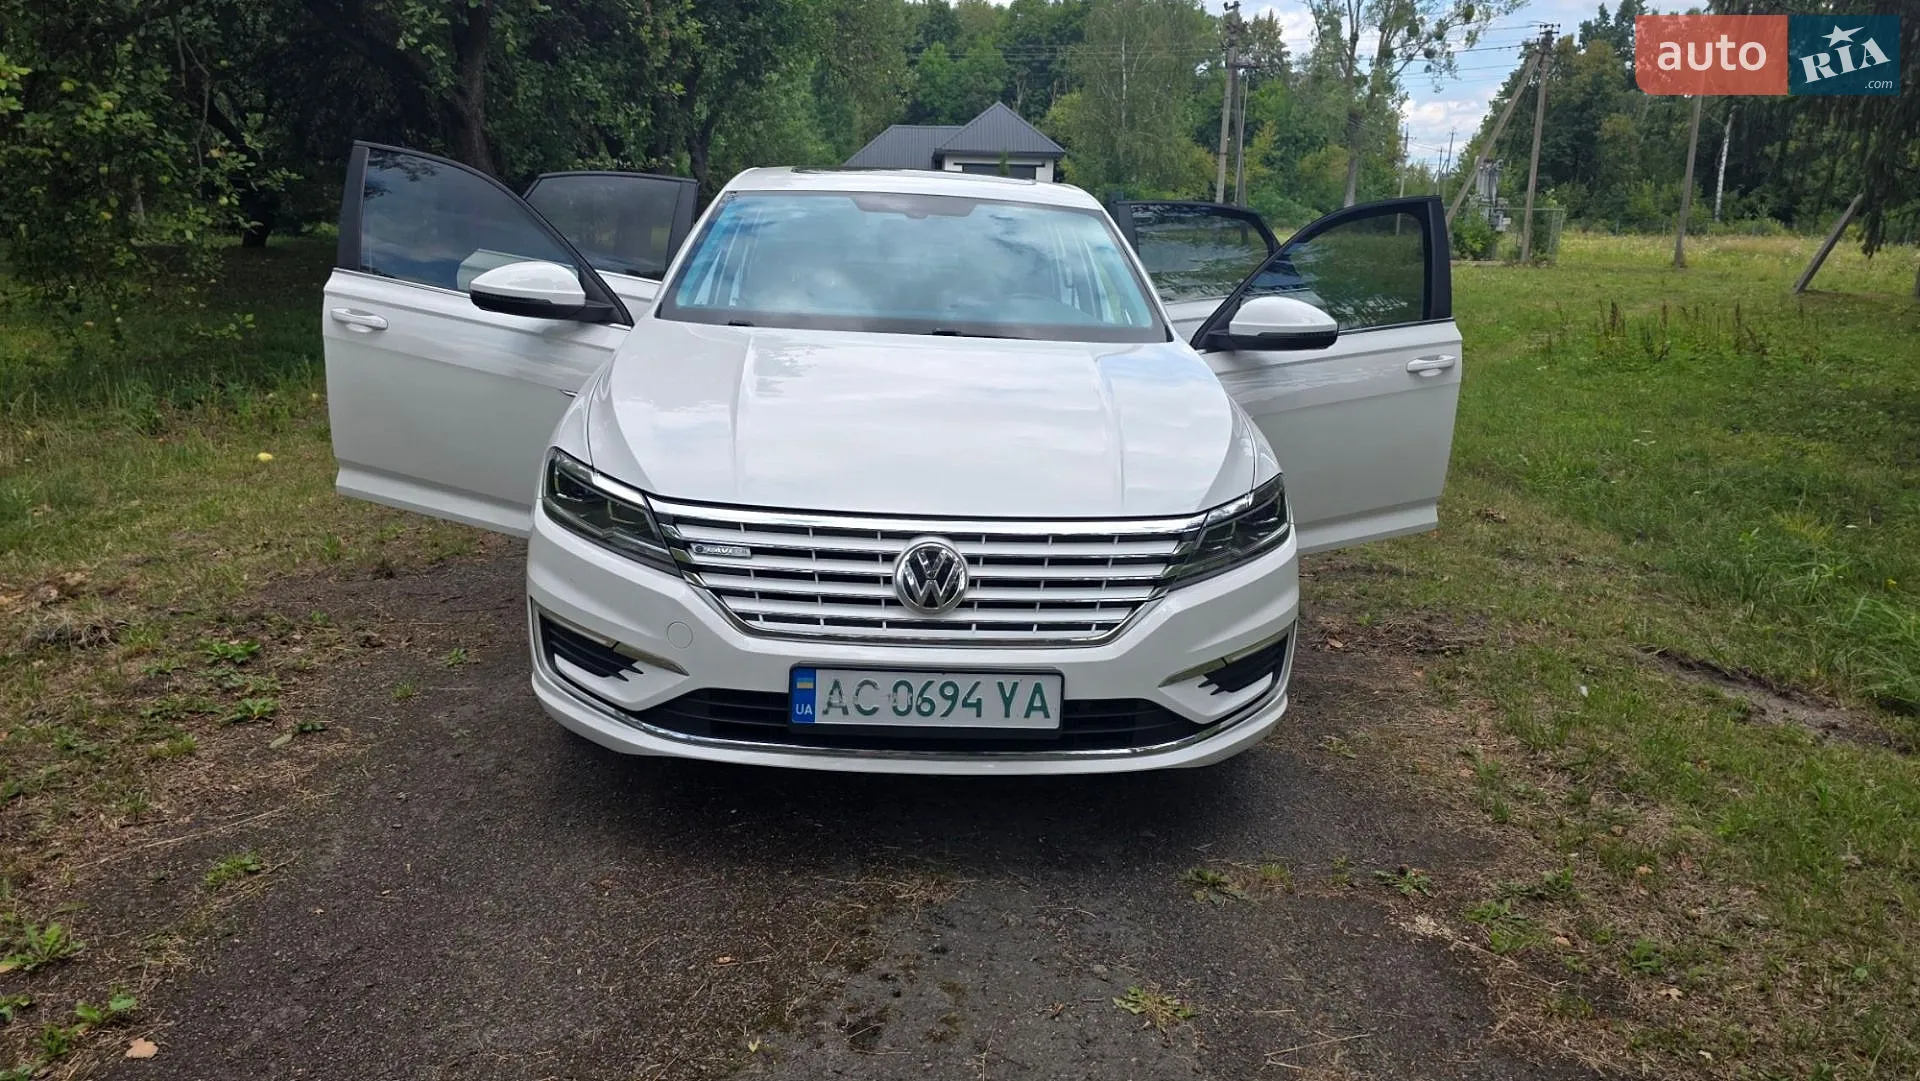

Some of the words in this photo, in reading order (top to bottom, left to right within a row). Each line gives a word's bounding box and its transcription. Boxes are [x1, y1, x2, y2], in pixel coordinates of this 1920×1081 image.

[796, 704, 813, 715] UA
[822, 679, 880, 716] AC
[892, 680, 983, 718] 0694
[997, 681, 1051, 719] YA
